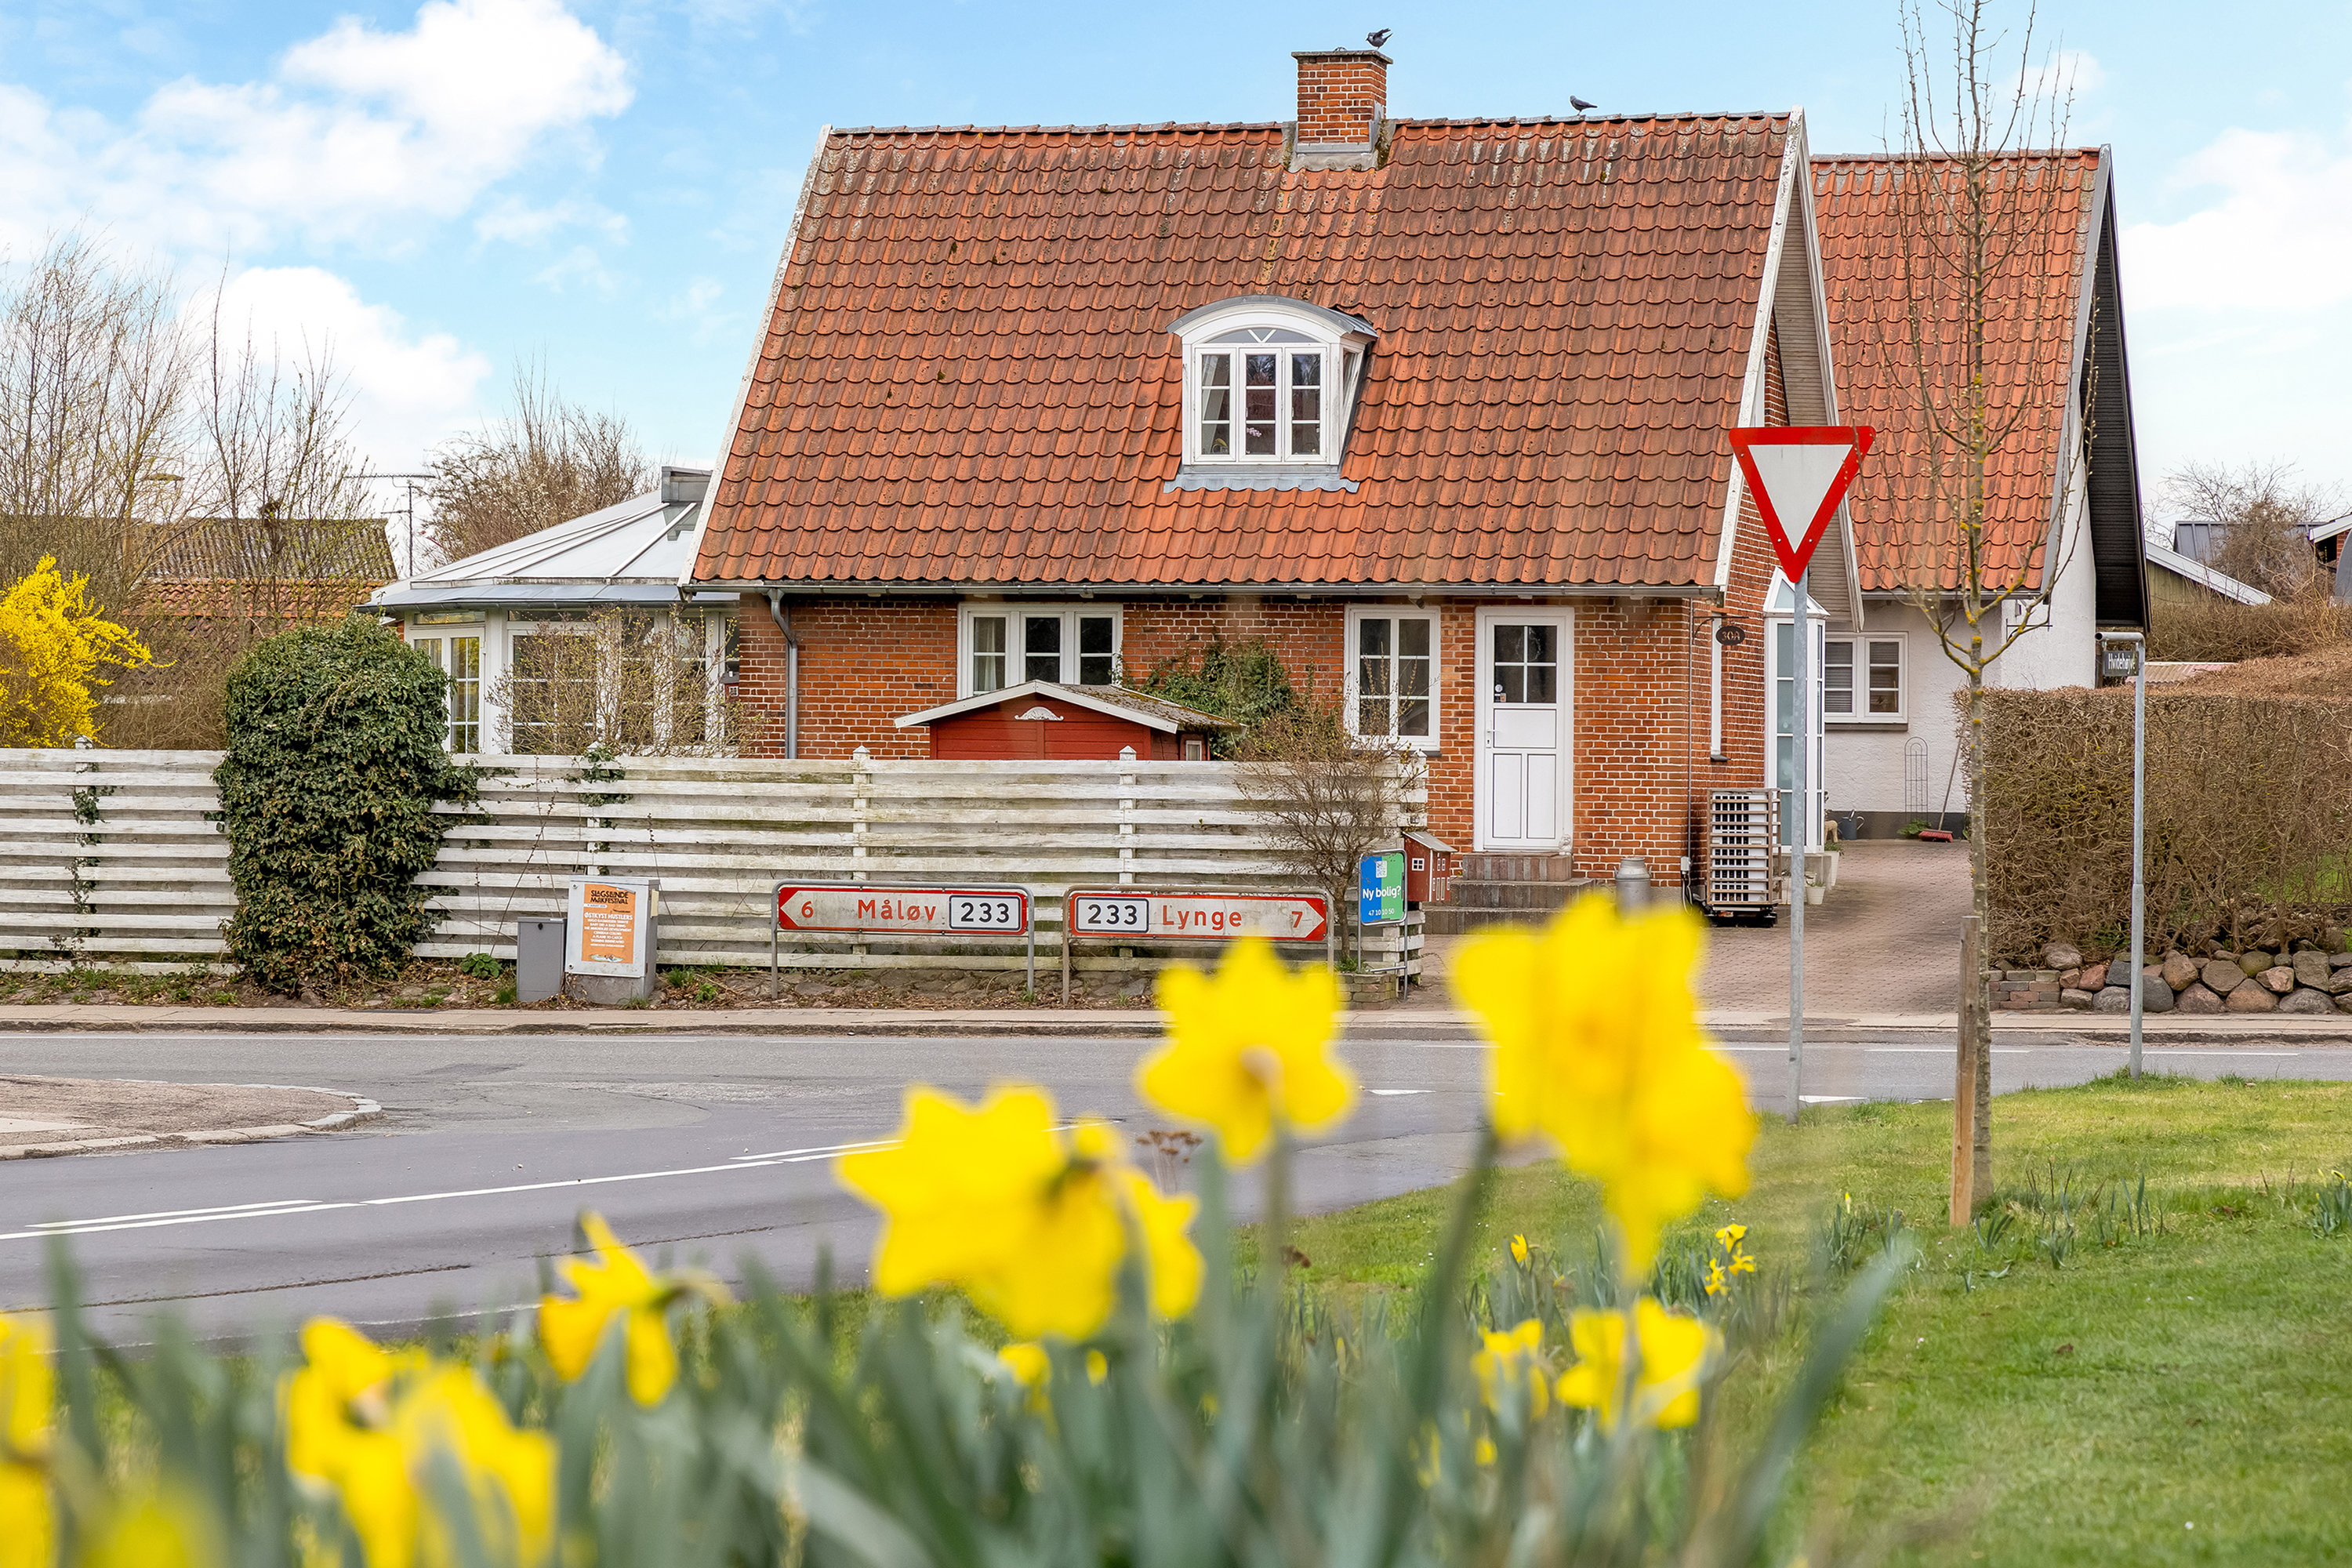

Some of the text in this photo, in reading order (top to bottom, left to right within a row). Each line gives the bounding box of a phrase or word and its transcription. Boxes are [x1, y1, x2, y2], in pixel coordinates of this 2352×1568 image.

[1722, 630, 1740, 641] 30A
[1363, 885, 1402, 901] Ny bolig?
[800, 899, 1010, 924] 6 Måløv 233
[1087, 904, 1304, 931] 233 Lynge 7
